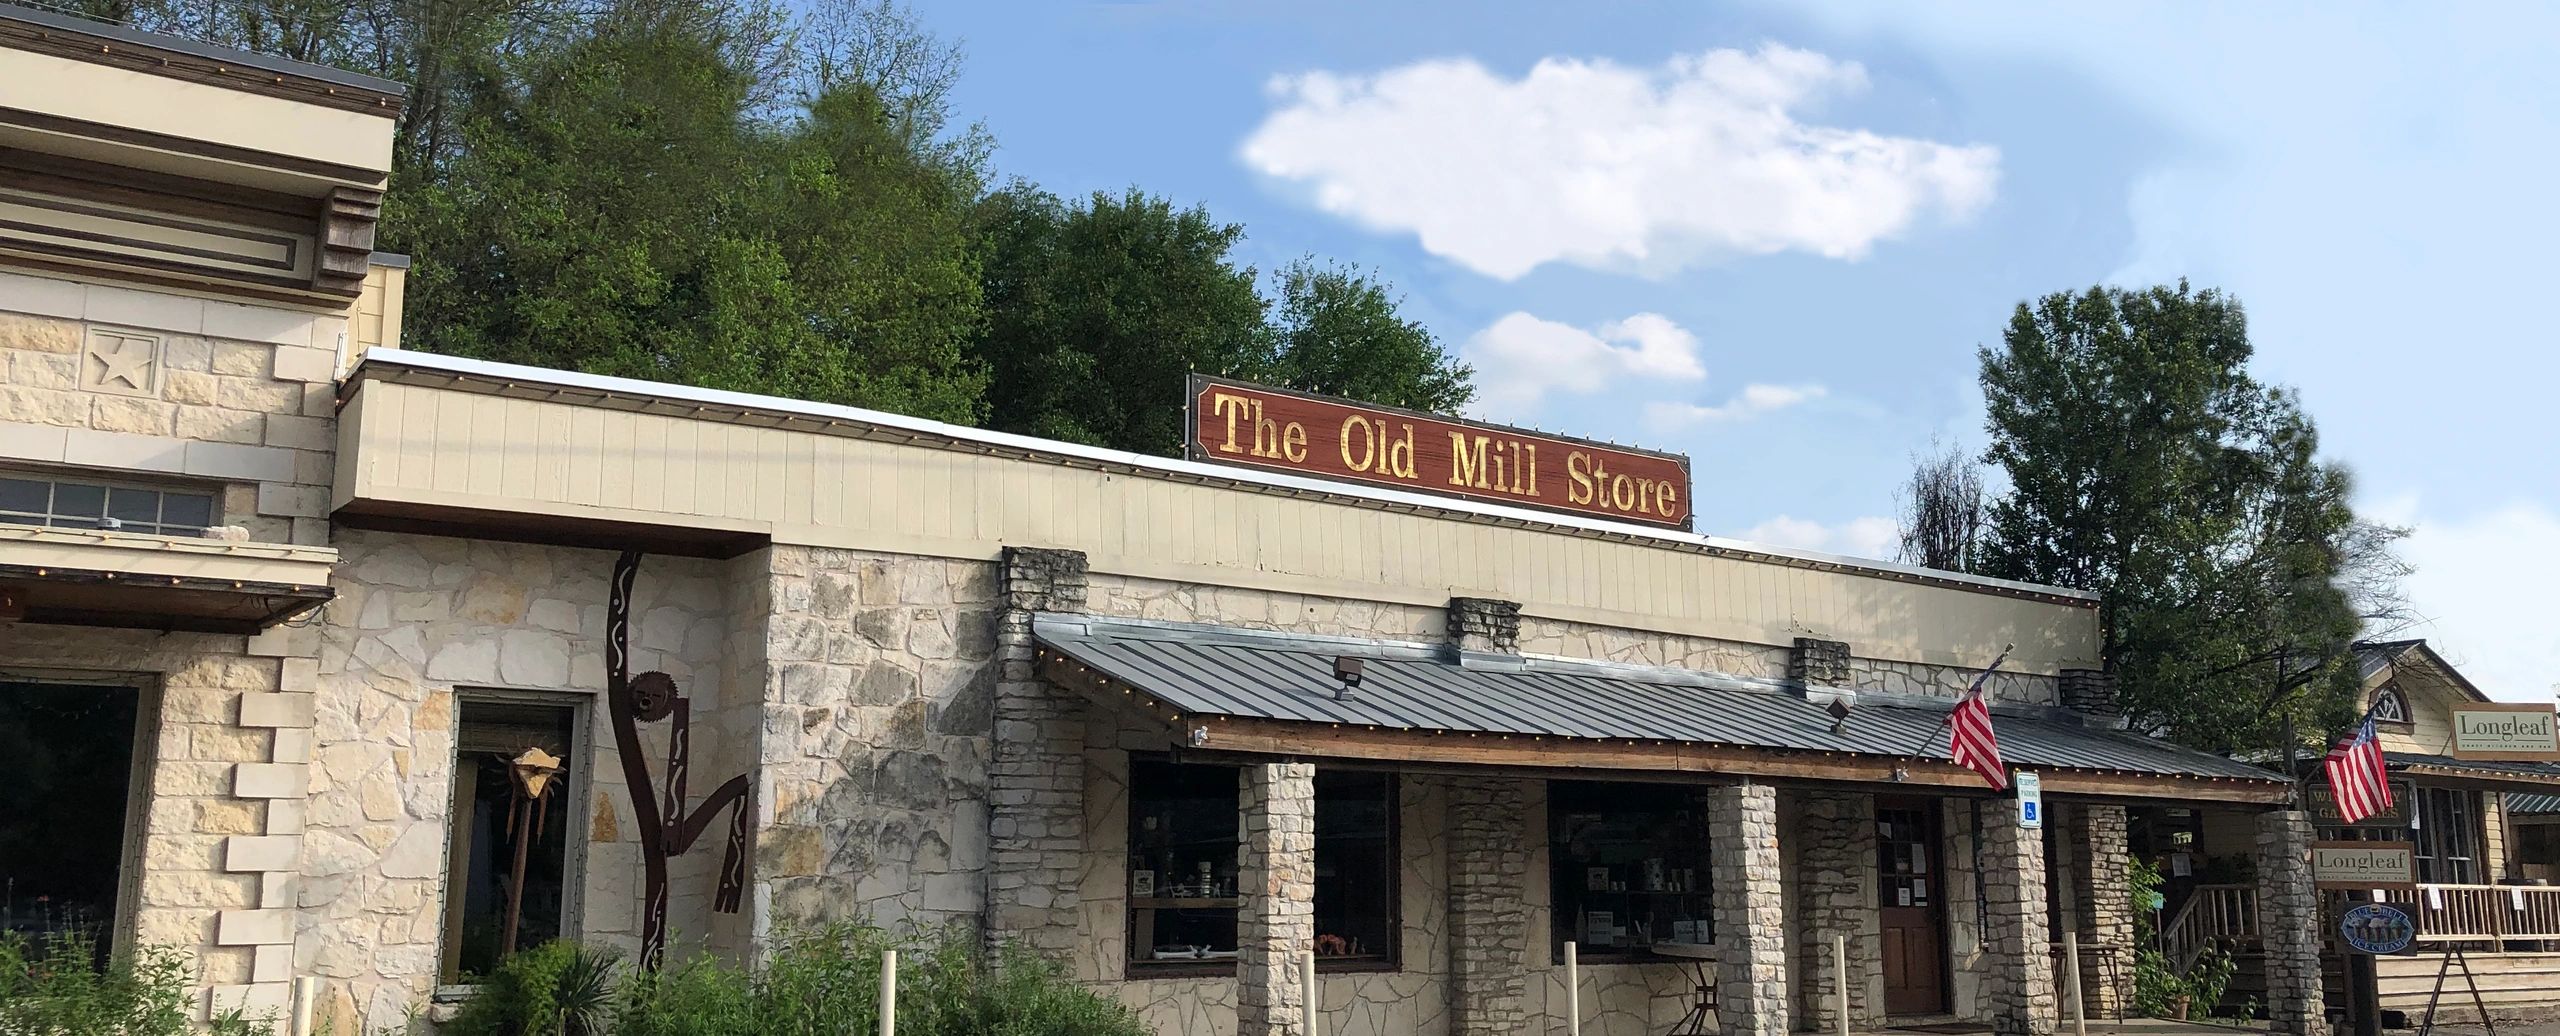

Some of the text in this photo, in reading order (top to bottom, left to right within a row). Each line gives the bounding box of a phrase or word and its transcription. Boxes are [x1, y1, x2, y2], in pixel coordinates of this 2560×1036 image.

[1214, 392, 1677, 519] The Old Mill Store
[2460, 715, 2549, 742] Longleaf
[2319, 851, 2406, 874] Longleaf
